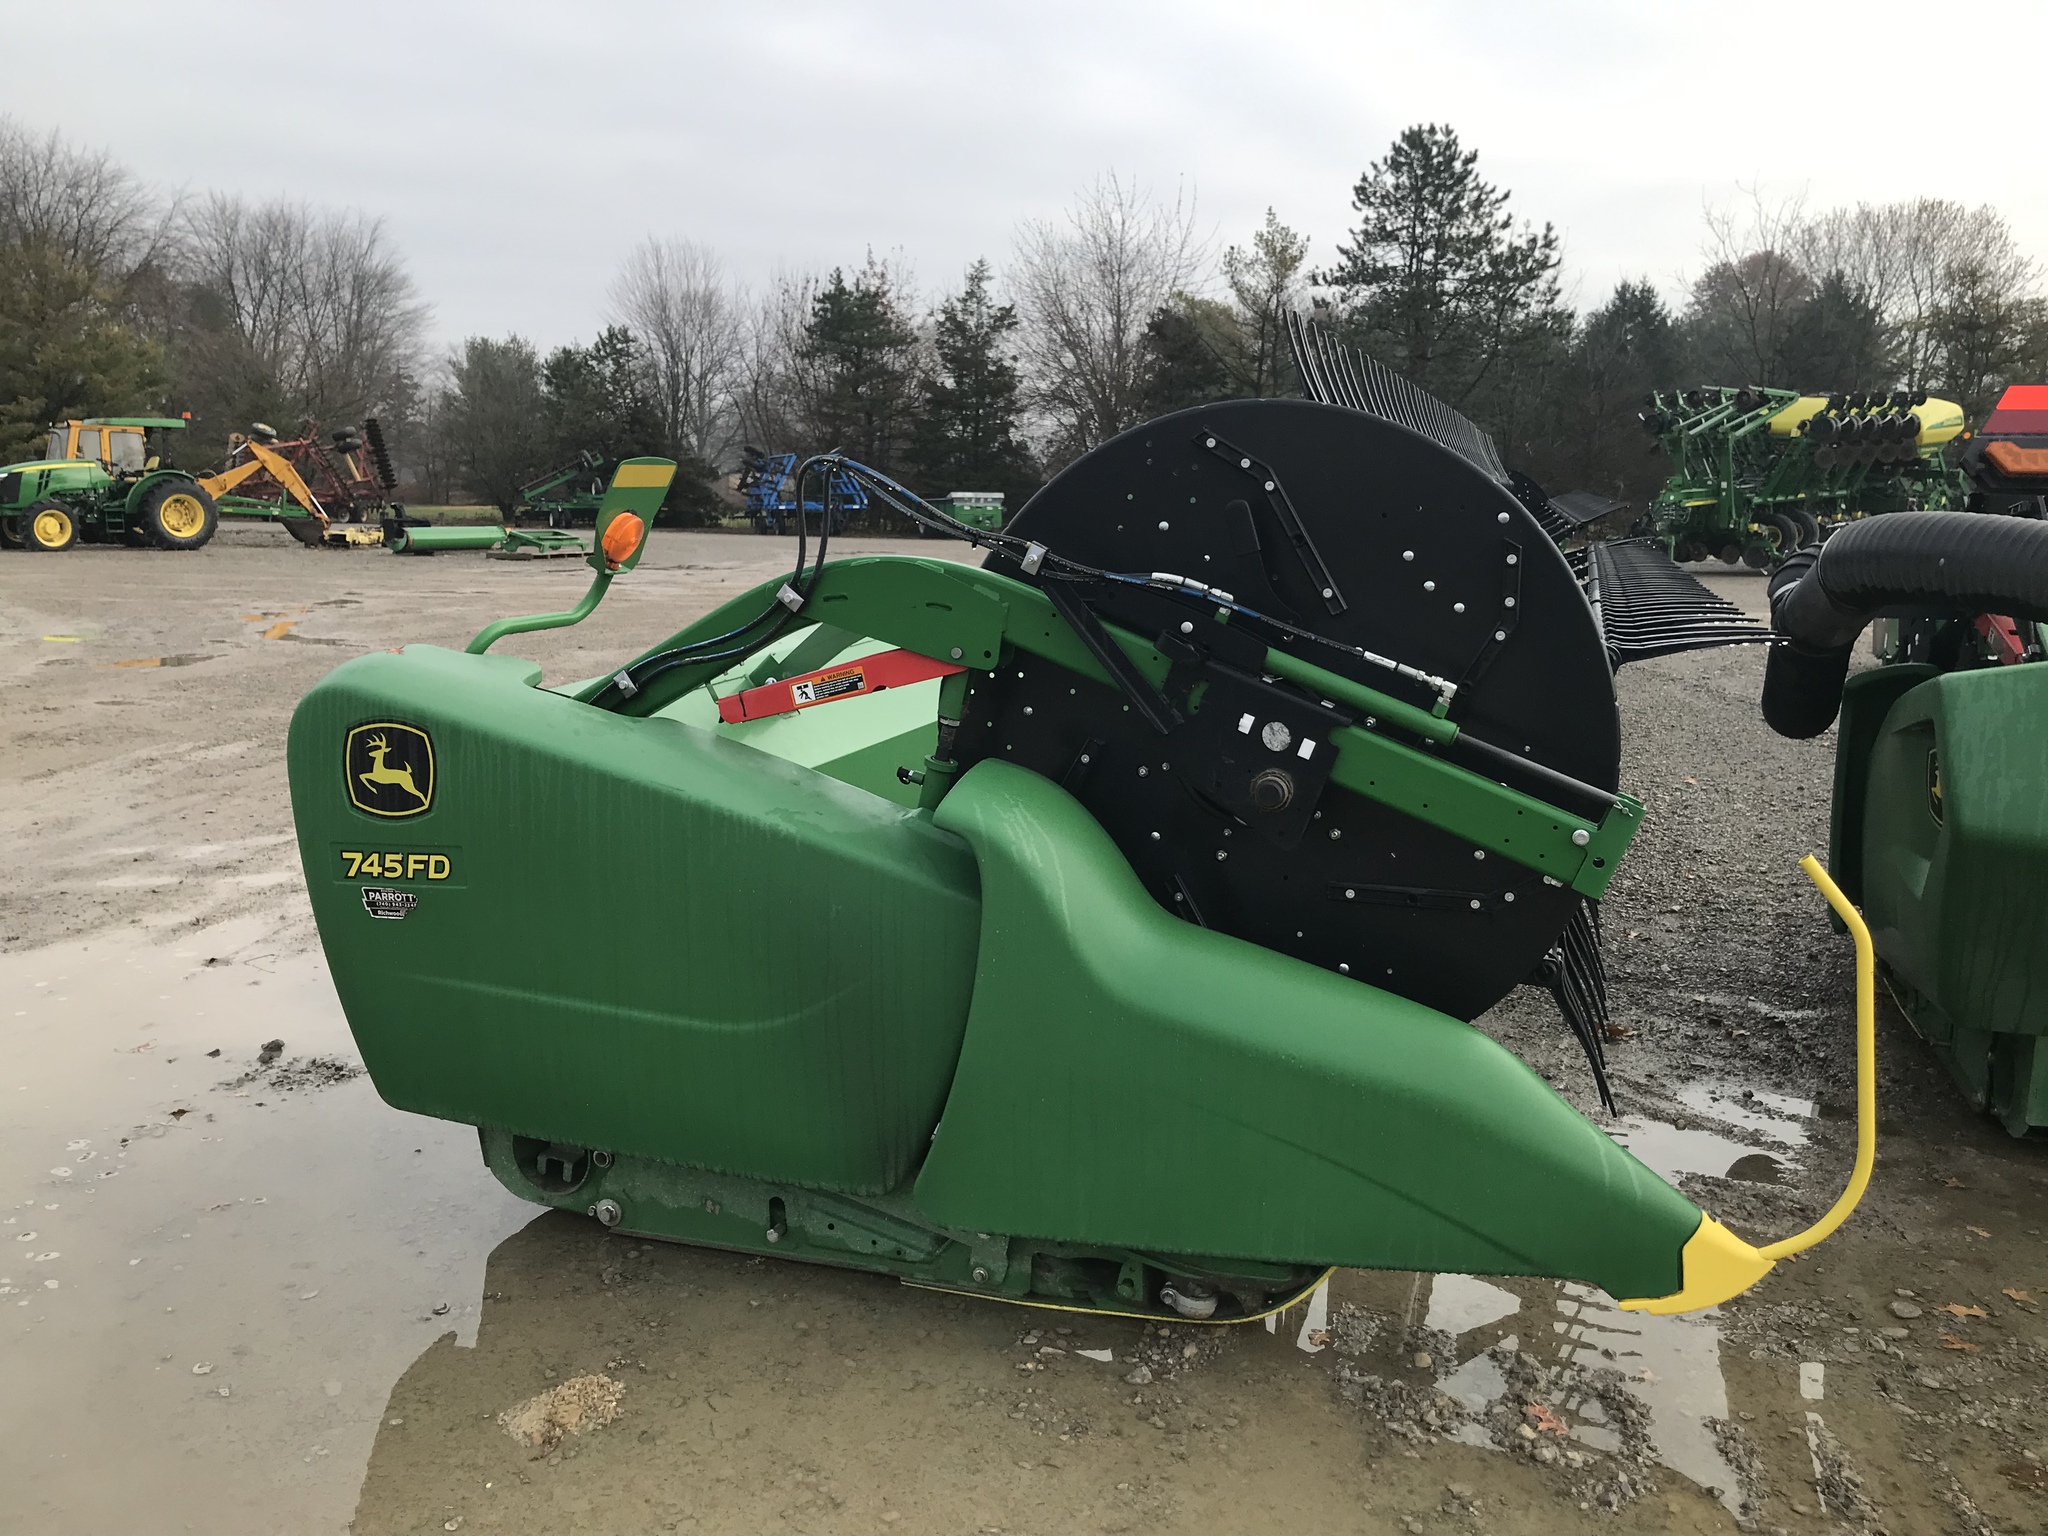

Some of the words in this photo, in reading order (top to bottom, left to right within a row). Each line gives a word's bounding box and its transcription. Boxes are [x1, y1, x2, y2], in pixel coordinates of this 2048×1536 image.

[827, 669, 855, 681] WARNING
[341, 851, 451, 879] 745FD
[368, 891, 413, 902] PARROTT
